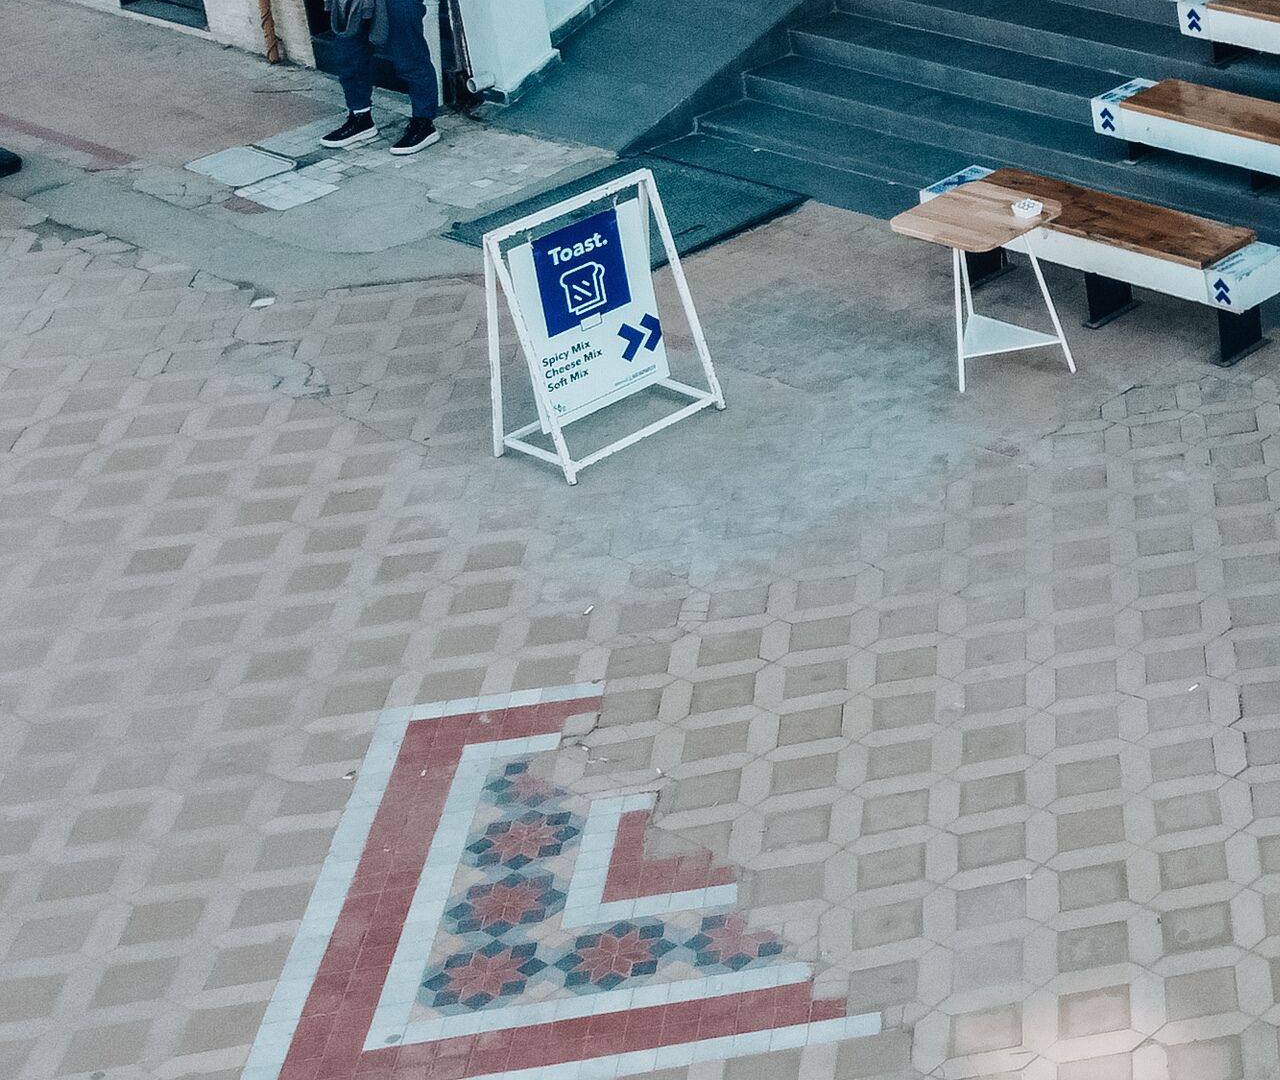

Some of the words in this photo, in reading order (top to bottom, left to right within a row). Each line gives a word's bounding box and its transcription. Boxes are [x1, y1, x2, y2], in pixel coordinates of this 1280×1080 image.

[547, 232, 608, 266] Toast.
[541, 350, 570, 368] Spicy
[571, 340, 592, 355] Mix
[544, 358, 582, 380] Cheese
[583, 348, 604, 363] Mix
[547, 376, 569, 394] Soft
[570, 367, 590, 383] Mix
